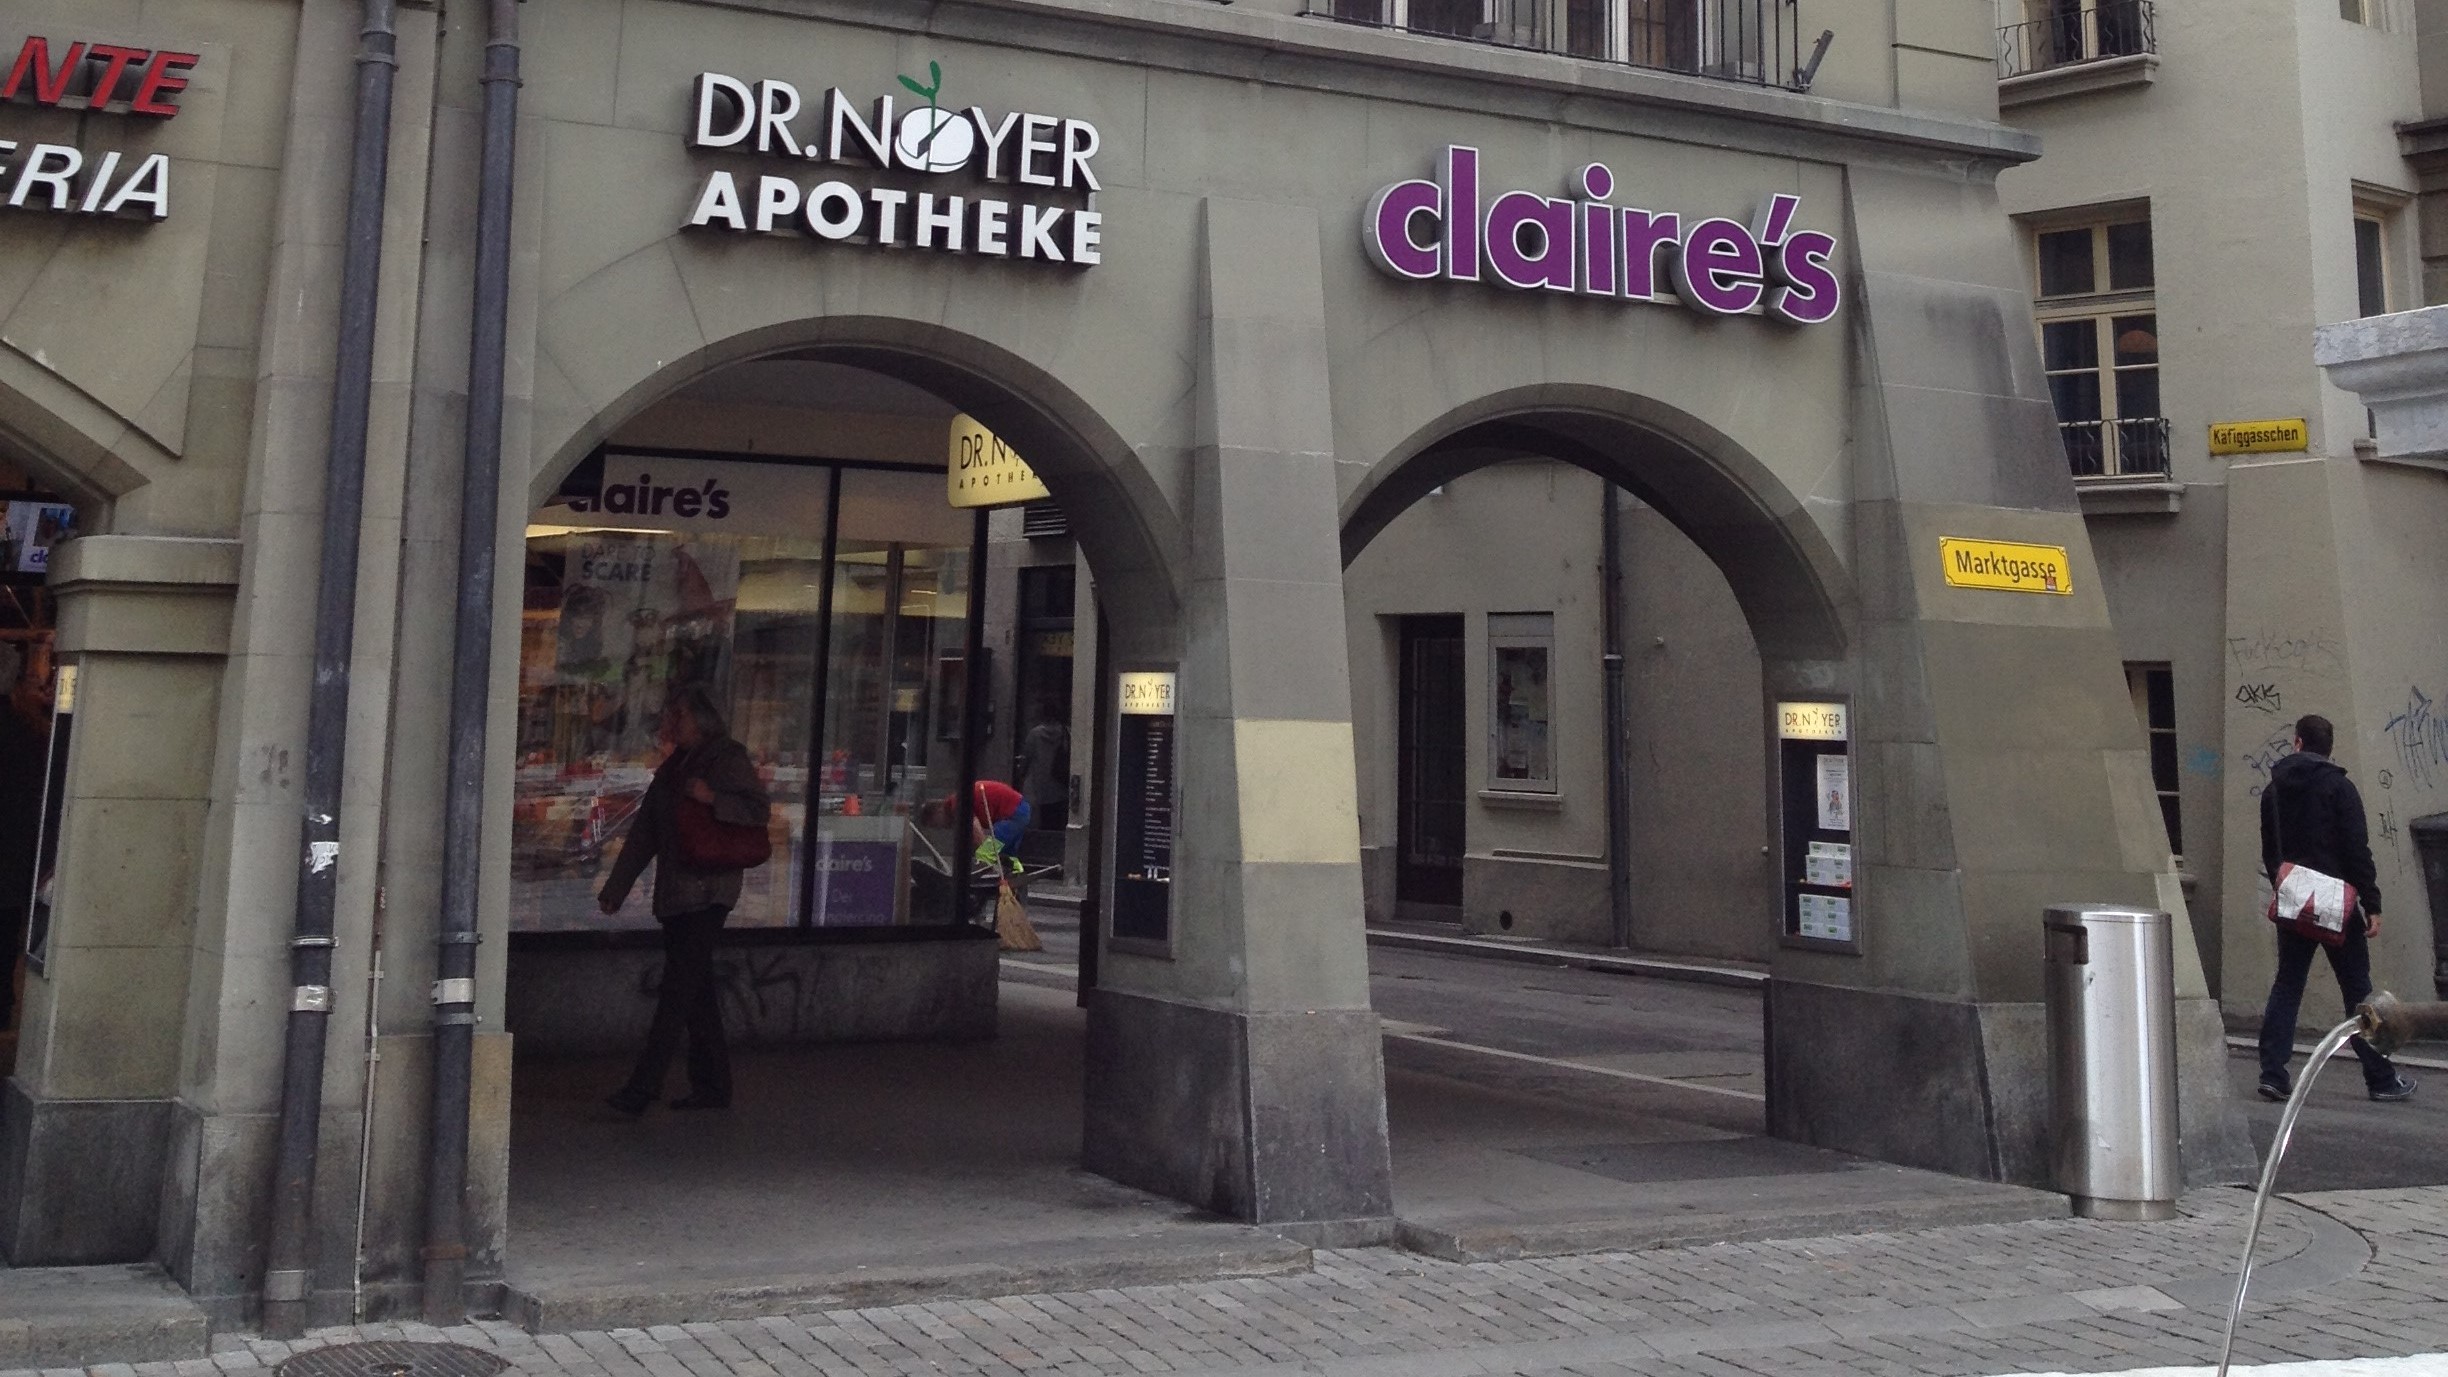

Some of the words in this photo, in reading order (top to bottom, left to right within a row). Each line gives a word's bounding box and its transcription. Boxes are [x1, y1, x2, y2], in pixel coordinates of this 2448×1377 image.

[690, 170, 1101, 264] APOTHEKE
[1374, 144, 1841, 324] claire's
[582, 560, 652, 581] SCARE
[1955, 549, 2057, 584] Marktgasse
[1125, 683, 1171, 699] DR.NYER
[1785, 712, 1841, 727] DR.NYER
